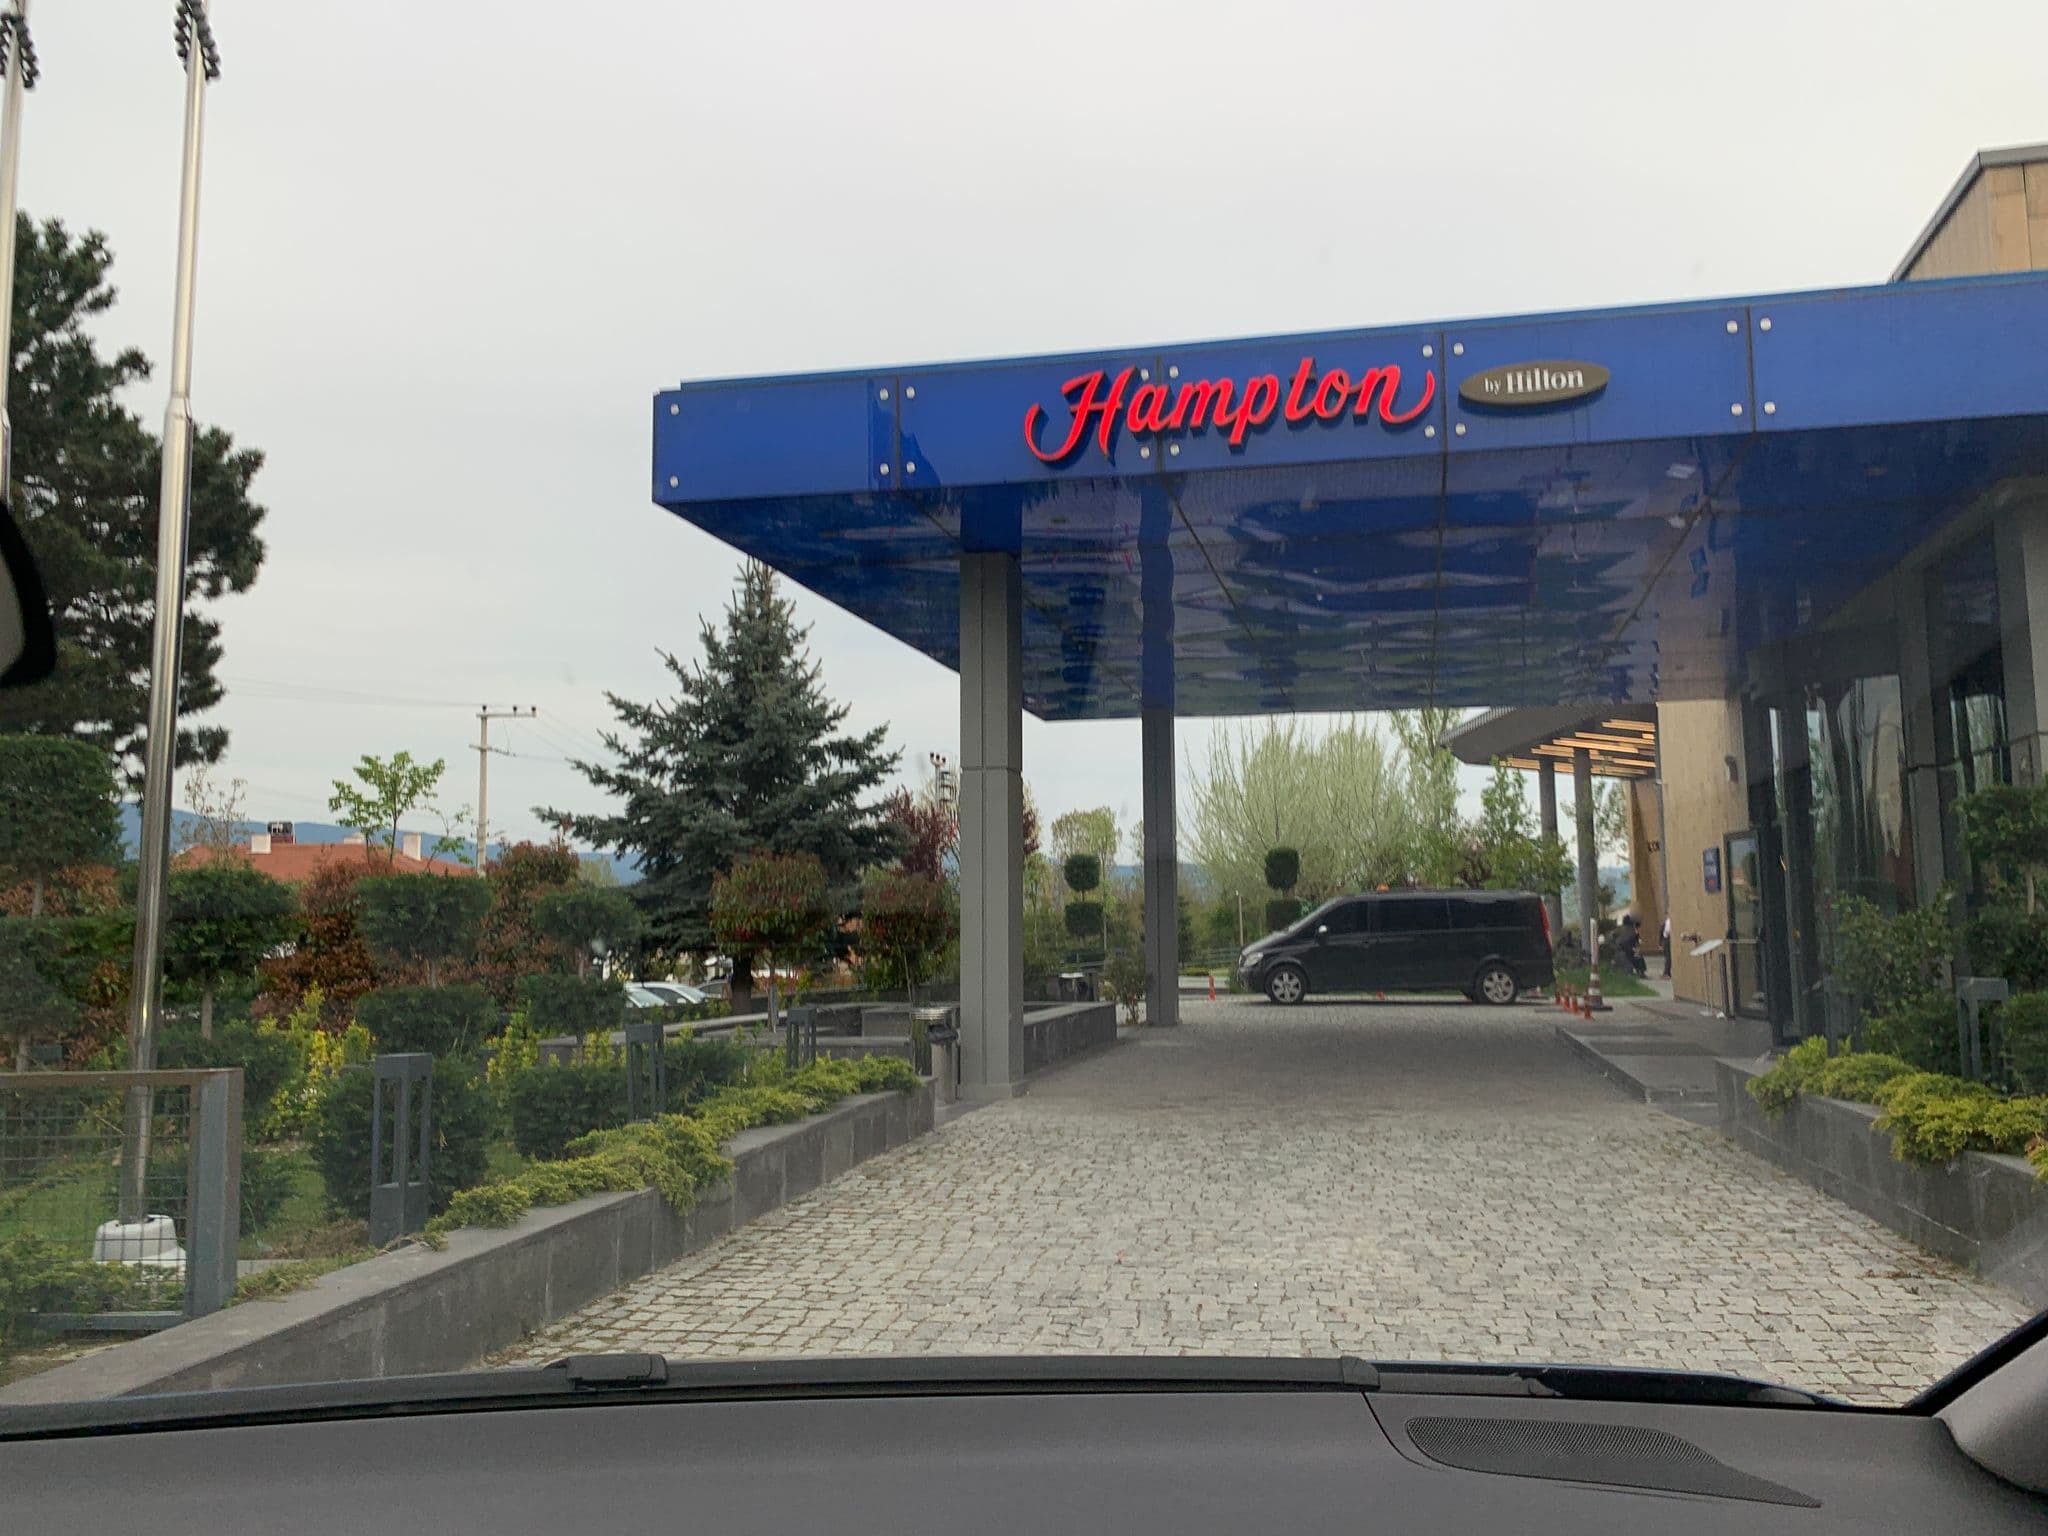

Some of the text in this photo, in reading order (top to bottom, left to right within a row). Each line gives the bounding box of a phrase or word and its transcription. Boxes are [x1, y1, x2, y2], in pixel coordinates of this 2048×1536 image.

[1024, 357, 1435, 462] Hampton
[1484, 367, 1584, 395] by Hilton
